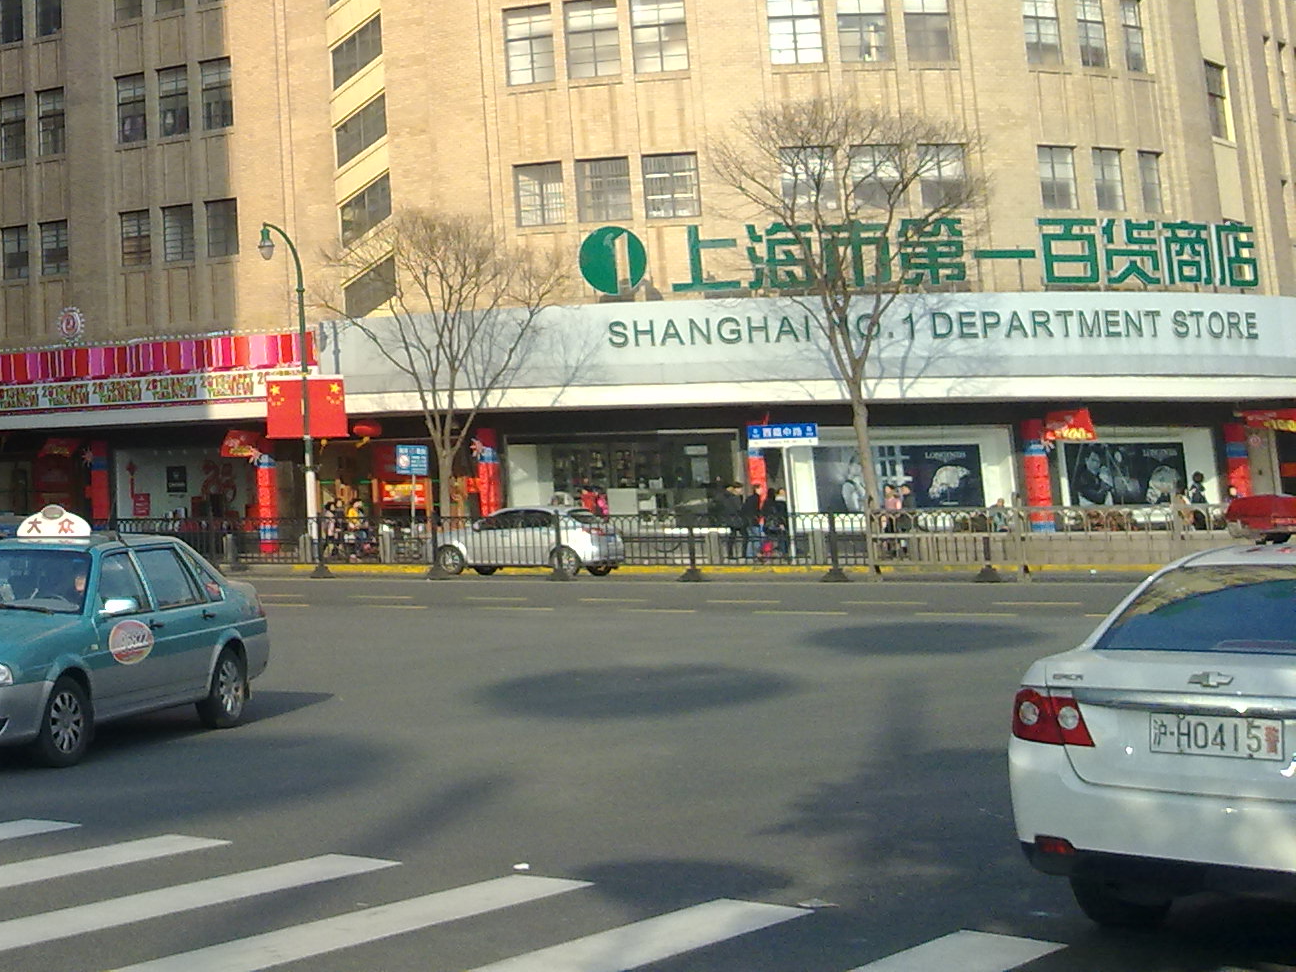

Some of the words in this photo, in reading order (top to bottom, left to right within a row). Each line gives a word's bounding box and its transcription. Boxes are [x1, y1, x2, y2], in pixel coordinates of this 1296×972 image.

[672, 218, 1259, 292] 上海市第一百货商店
[608, 315, 811, 348] SHANGHAI
[931, 310, 1161, 340] DEPARTMENT
[1172, 309, 1259, 340] STORE
[27, 518, 75, 534] 大众
